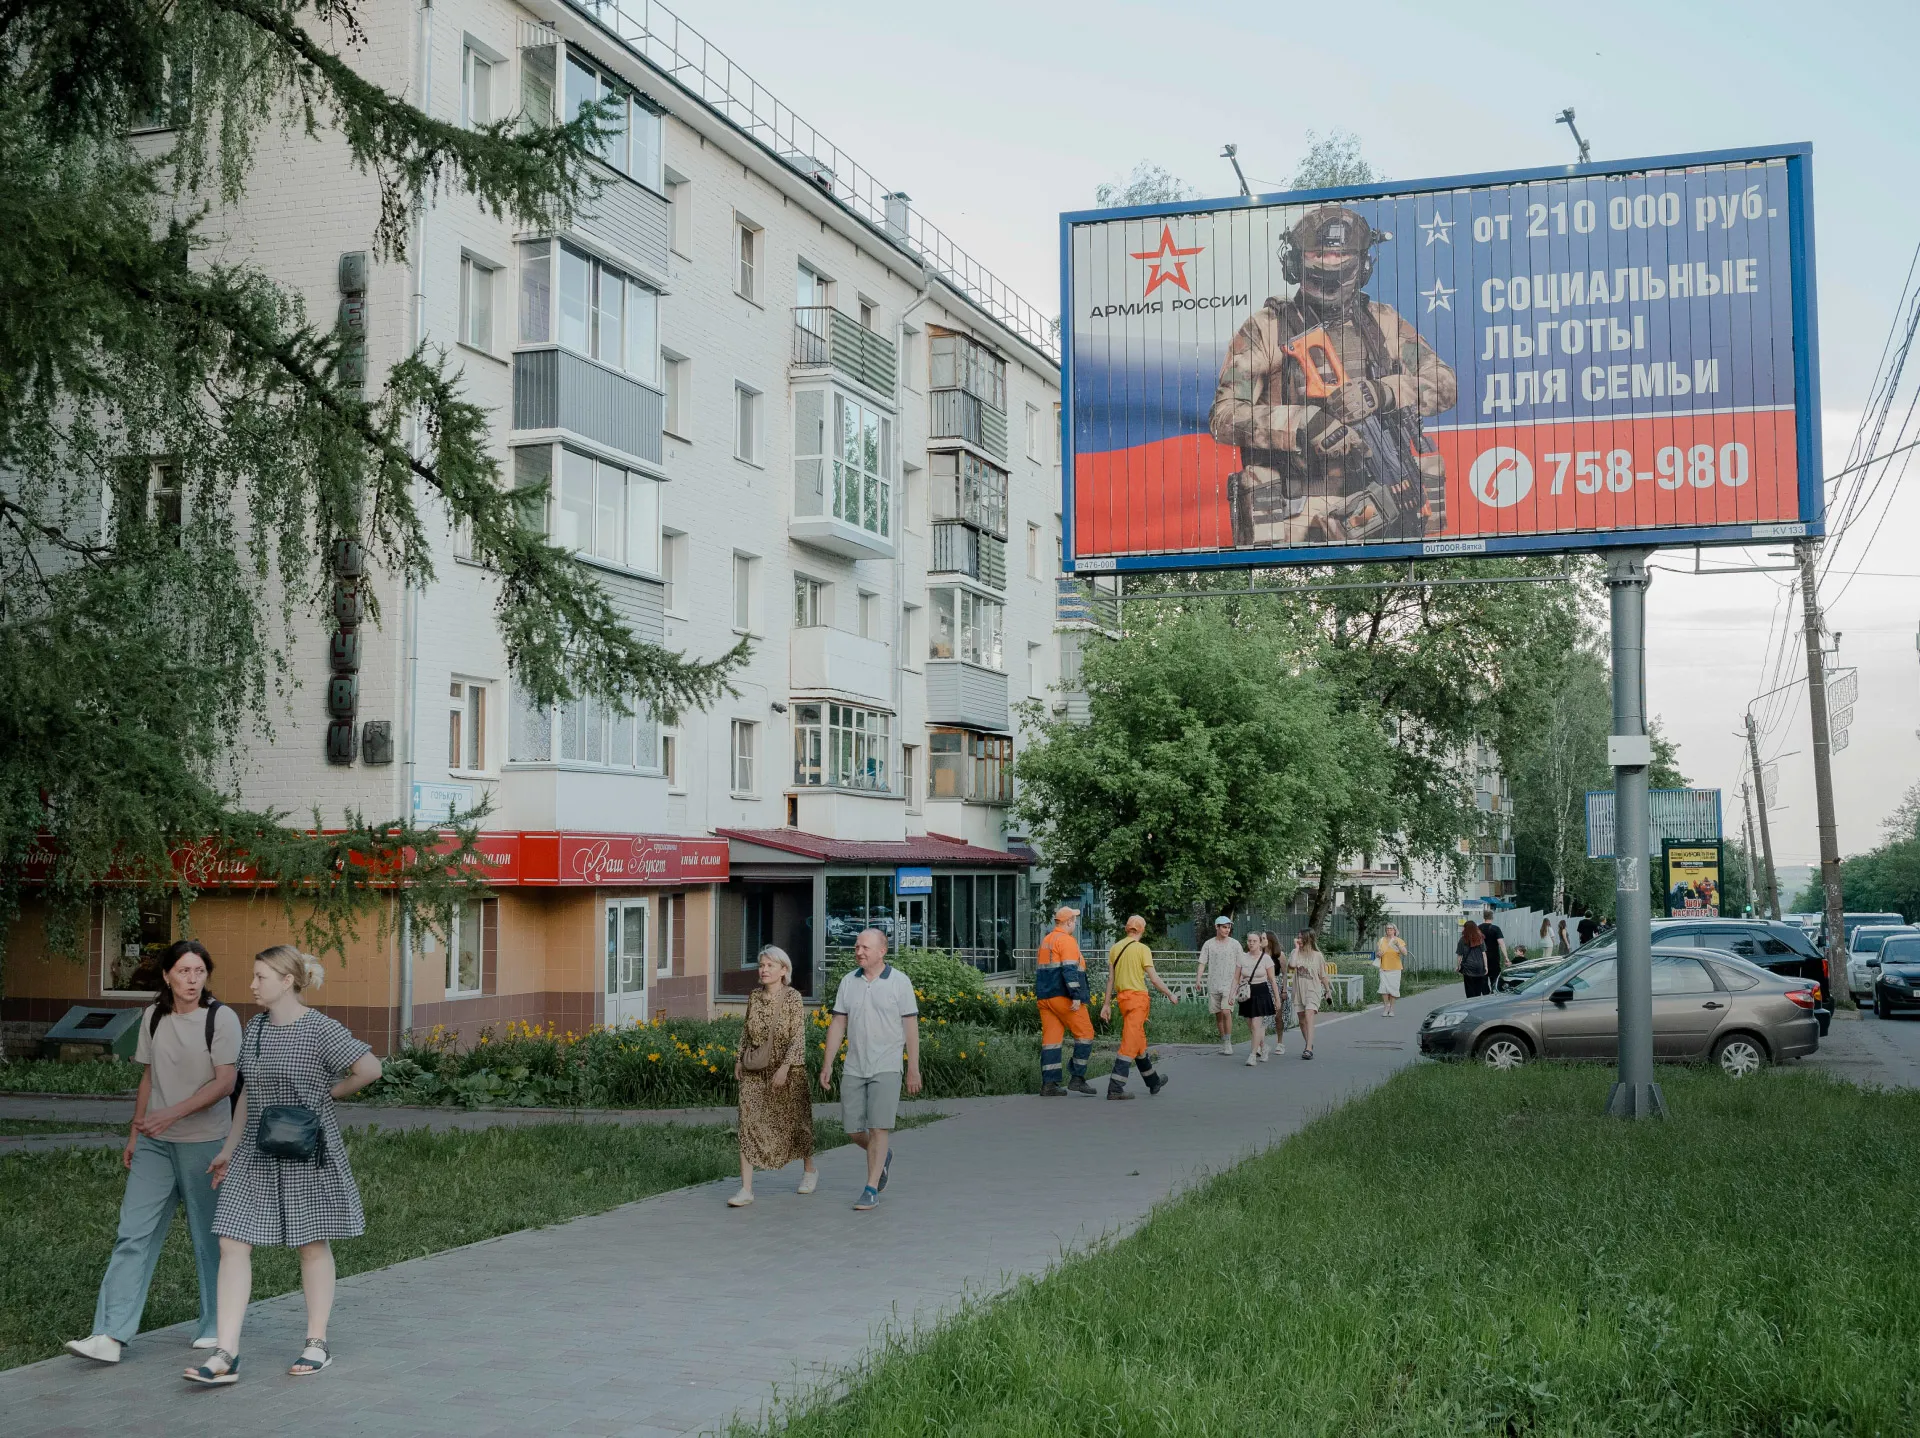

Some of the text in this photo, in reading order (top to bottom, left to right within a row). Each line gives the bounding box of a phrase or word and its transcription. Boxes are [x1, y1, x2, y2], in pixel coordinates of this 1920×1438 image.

[1473, 184, 1778, 243] от 210 000 руб.
[1089, 294, 1248, 319] АРМИЯ РОССИИ
[1481, 258, 1759, 314] СОЦИАЛЬНЫЕ
[1481, 315, 1645, 361] ЛЬГОТЫ
[1482, 358, 1719, 414] ДЛЯ СЕМЬИ
[1544, 442, 1749, 496] 758-980
[1772, 526, 1804, 535] KV 133
[1084, 560, 1115, 569] 476-000
[430, 790, 463, 801] ГОРЬКОГО
[573, 836, 666, 883] Ваш Букет
[700, 855, 721, 865] салон
